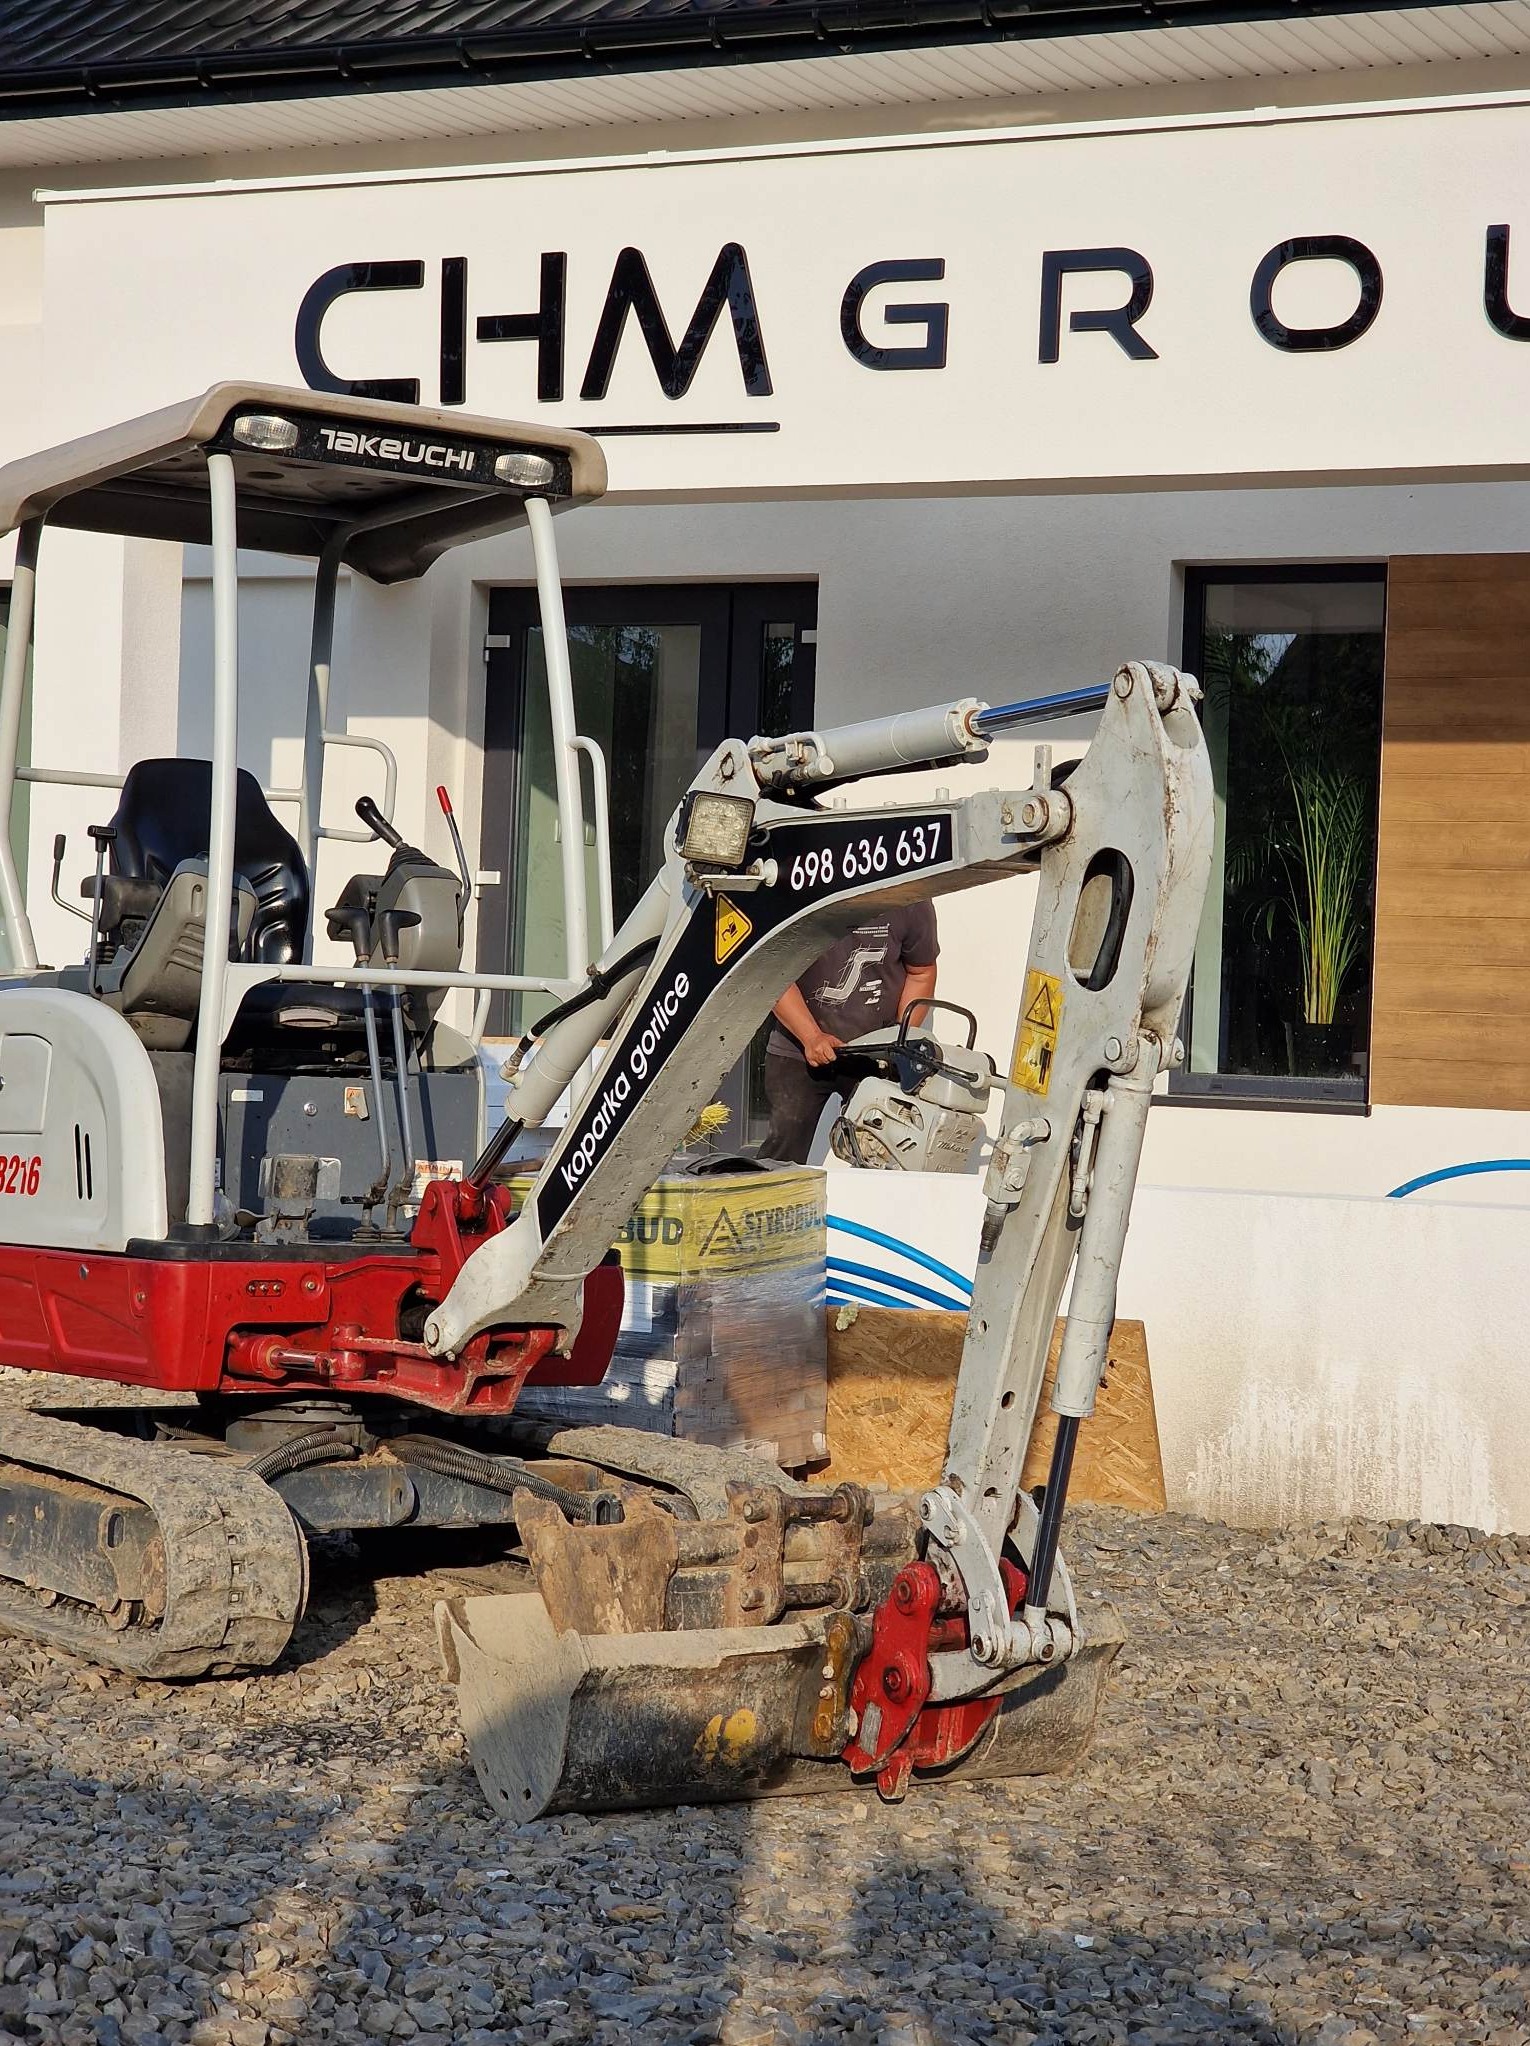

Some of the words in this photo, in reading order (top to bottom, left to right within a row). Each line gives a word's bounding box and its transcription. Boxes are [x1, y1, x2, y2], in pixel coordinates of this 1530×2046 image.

[294, 242, 774, 405] CHM
[320, 428, 475, 471] TAKEUCHI
[790, 847, 835, 891] 698
[842, 835, 888, 879] 636
[895, 822, 941, 867] 637
[560, 1071, 631, 1191] koparka
[630, 972, 690, 1080] gorlice
